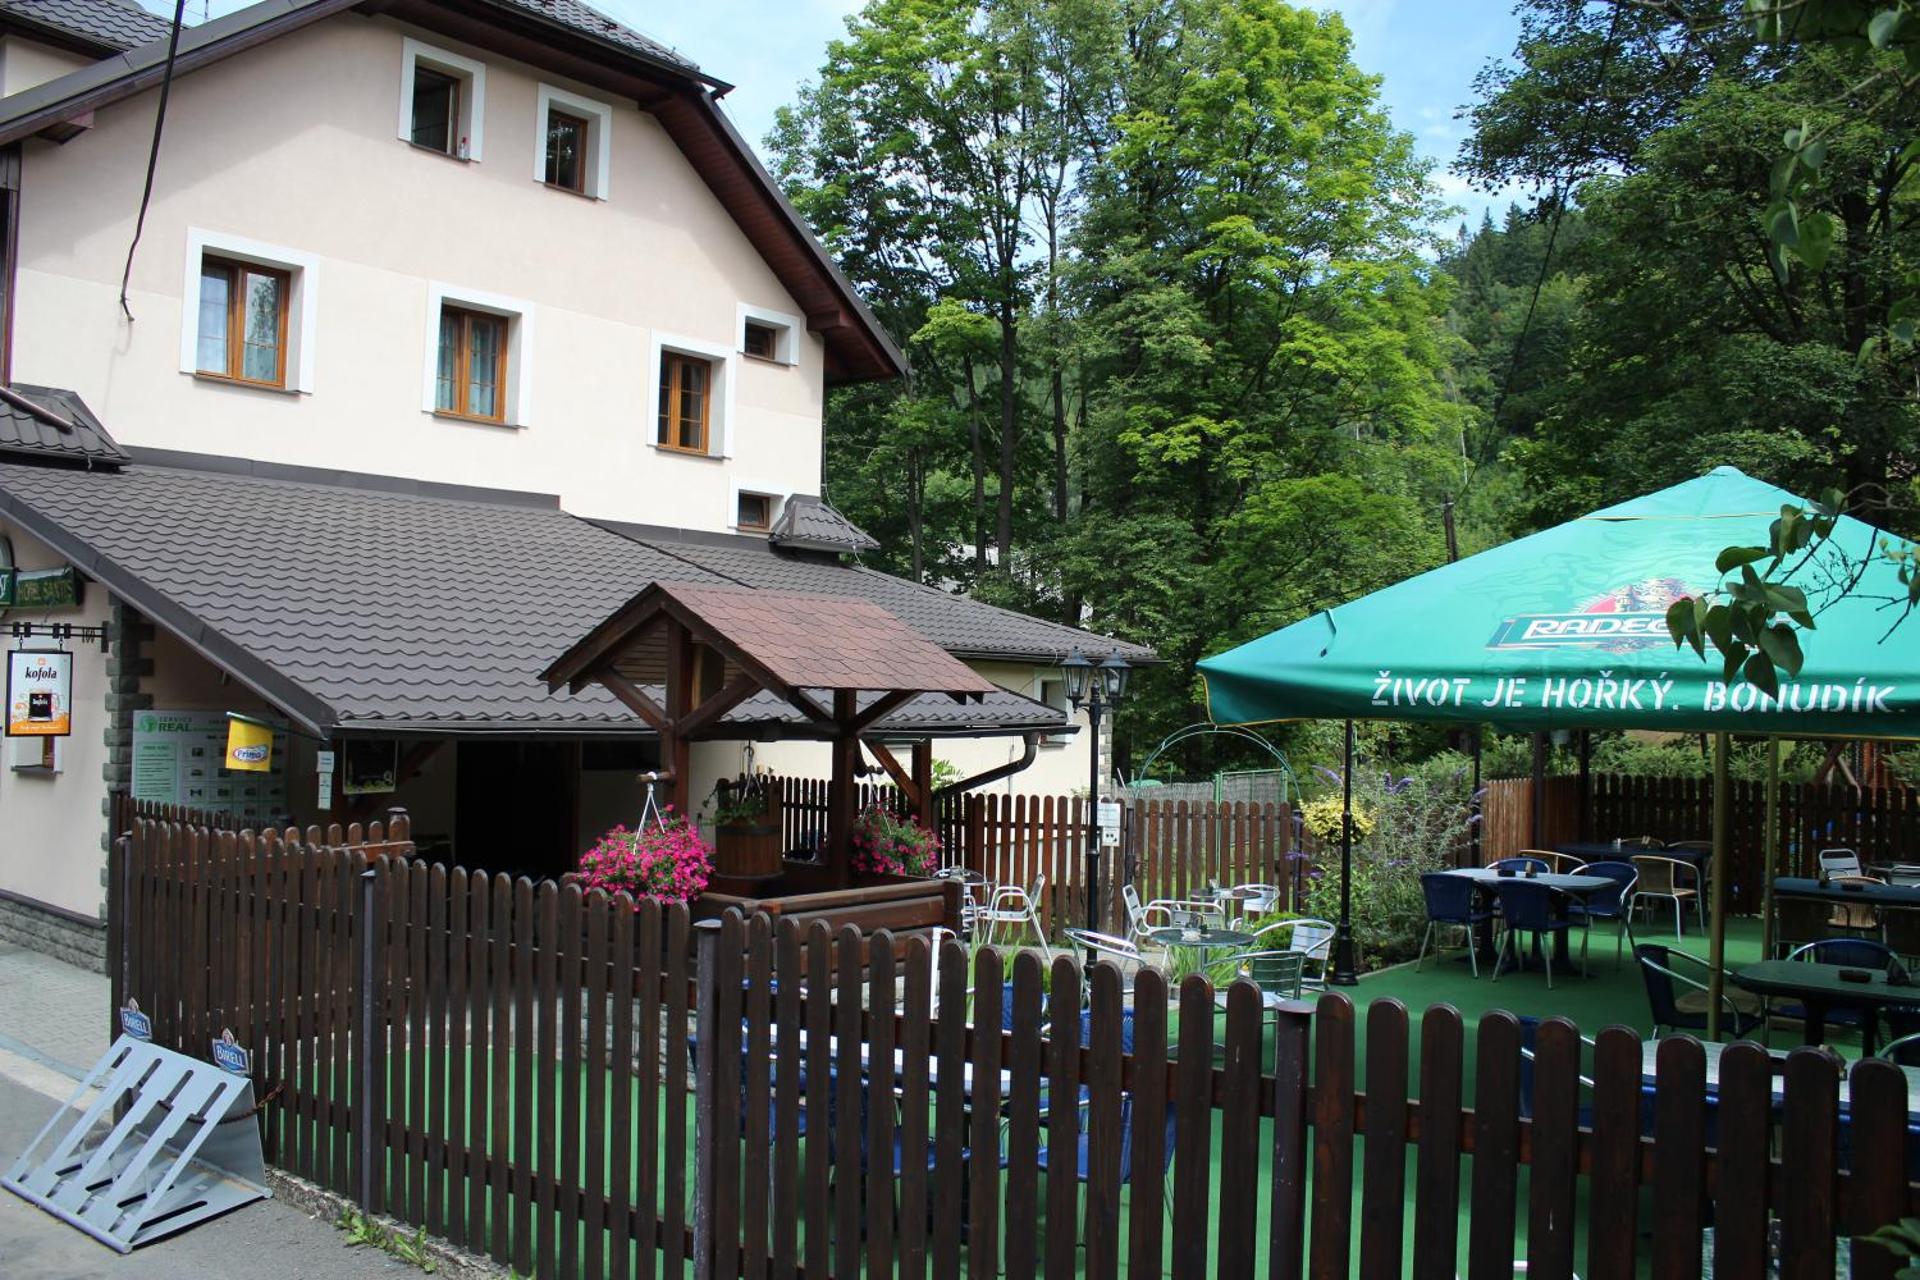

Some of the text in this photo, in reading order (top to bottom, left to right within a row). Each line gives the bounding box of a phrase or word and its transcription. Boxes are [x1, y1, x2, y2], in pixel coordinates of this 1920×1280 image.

[1522, 617, 1668, 640] RADEG
[25, 666, 57, 682] kofola
[1371, 670, 1906, 713] ŽIVOT JE HOŘKÝ. BOHUDÍK.
[158, 722, 192, 732] REAL
